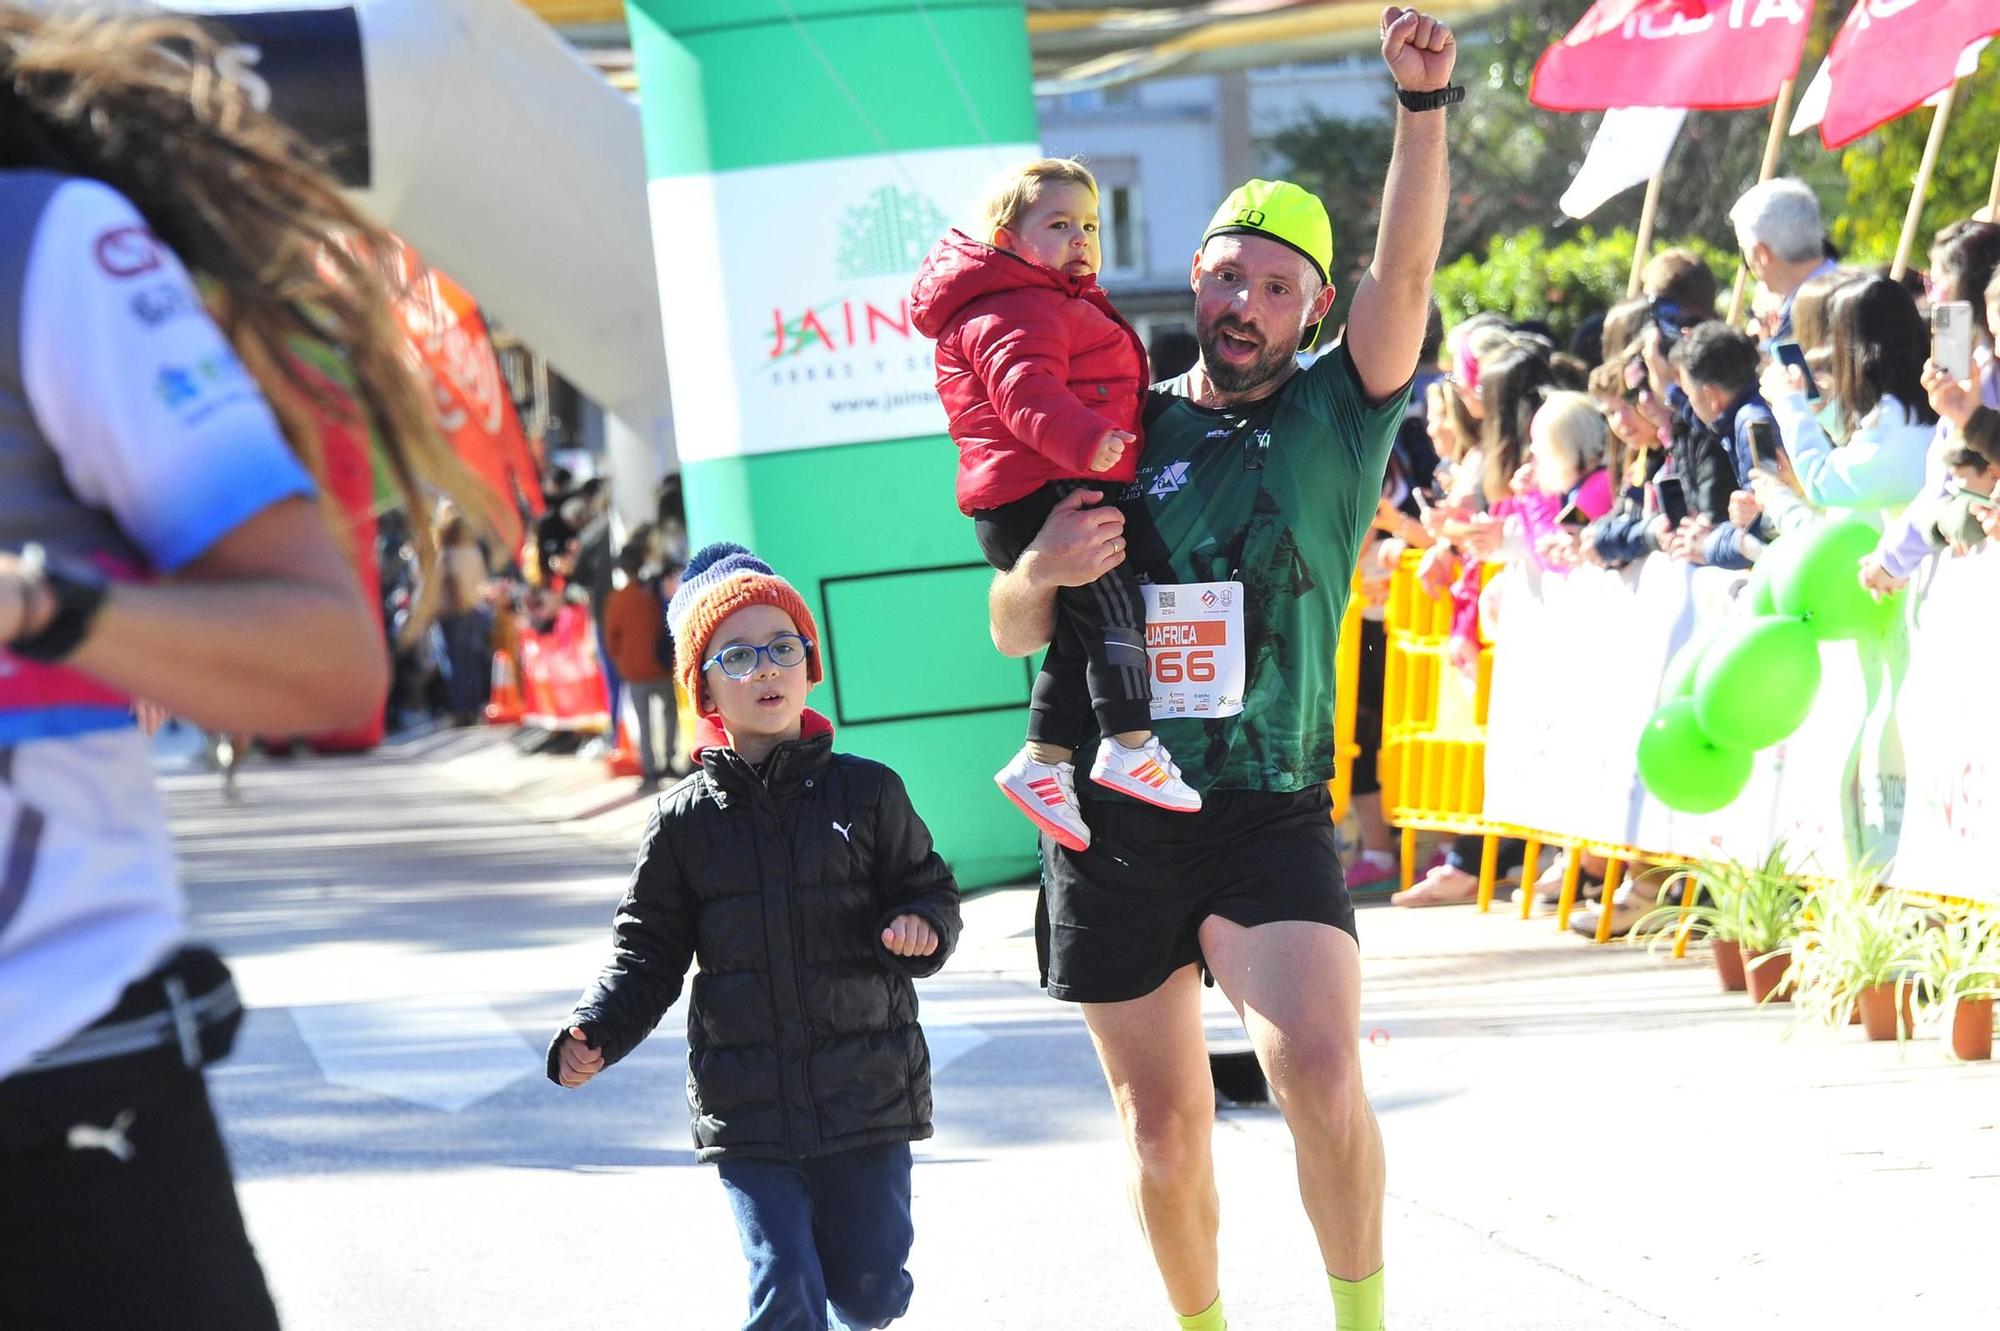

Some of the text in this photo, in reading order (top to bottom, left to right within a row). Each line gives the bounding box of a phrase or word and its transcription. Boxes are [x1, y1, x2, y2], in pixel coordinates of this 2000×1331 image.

[769, 297, 912, 359] JAIN
[906, 352, 936, 373] SE
[1143, 624, 1198, 646] UAFRICA
[1147, 650, 1216, 683] 66
